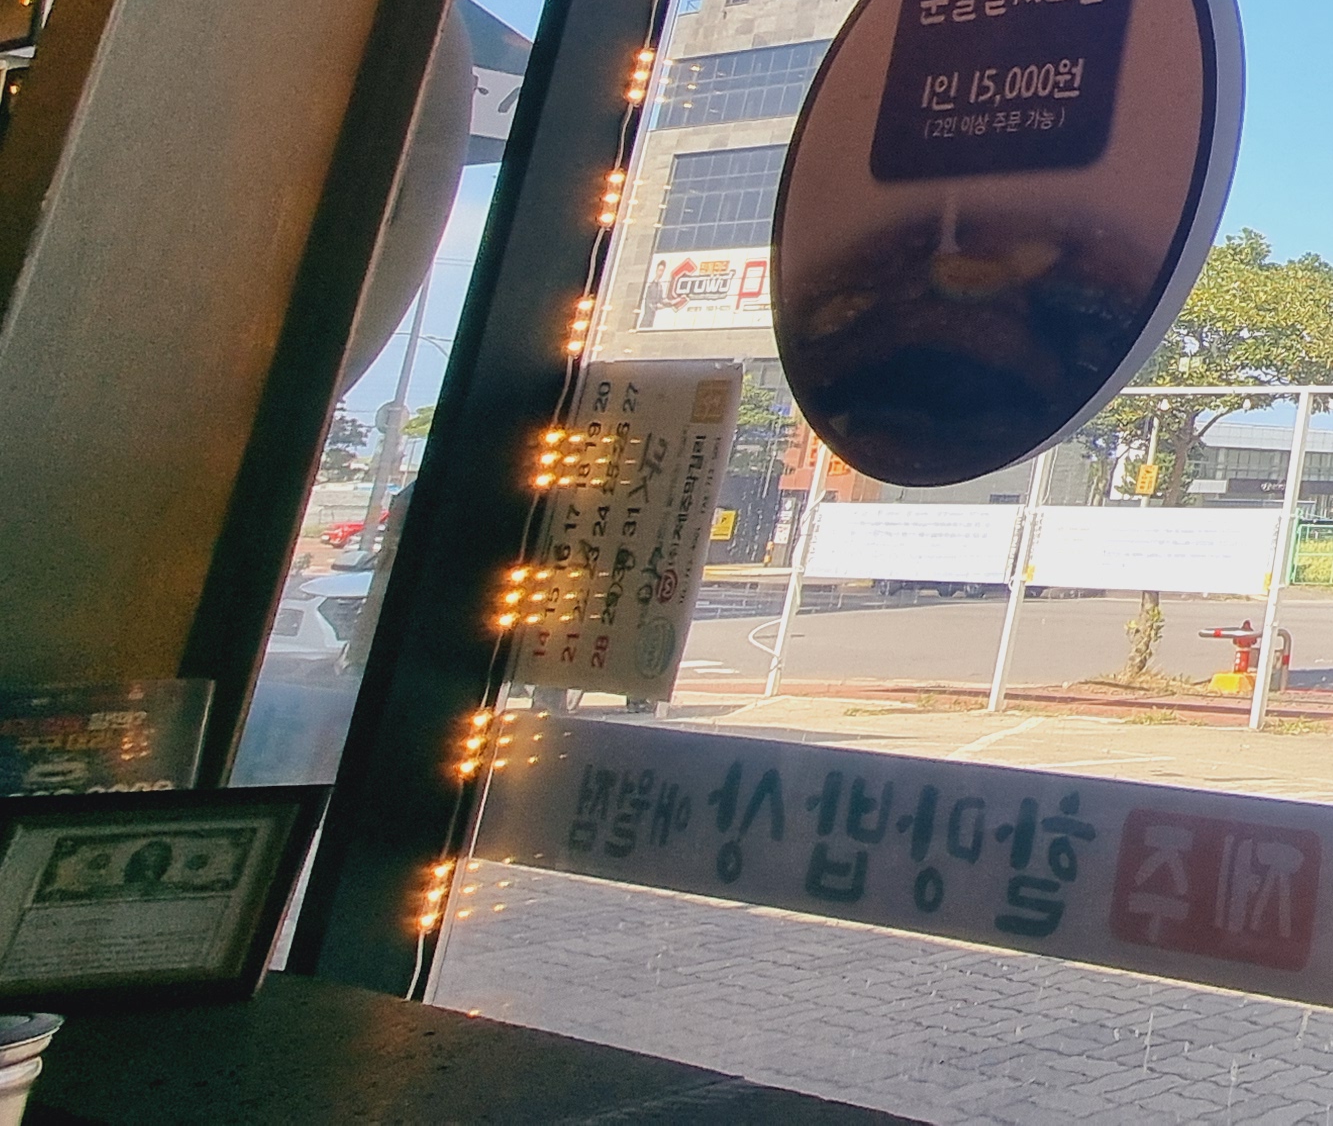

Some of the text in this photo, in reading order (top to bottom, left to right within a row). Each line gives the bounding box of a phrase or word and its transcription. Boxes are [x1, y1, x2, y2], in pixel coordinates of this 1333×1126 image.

[920, 58, 1085, 111] 1인 15,000원
[960, 112, 990, 136] 이상
[992, 110, 1022, 134] 주문
[564, 504, 580, 533] 17
[594, 381, 611, 413] 20
[592, 505, 611, 537] 24
[622, 381, 640, 413] 27
